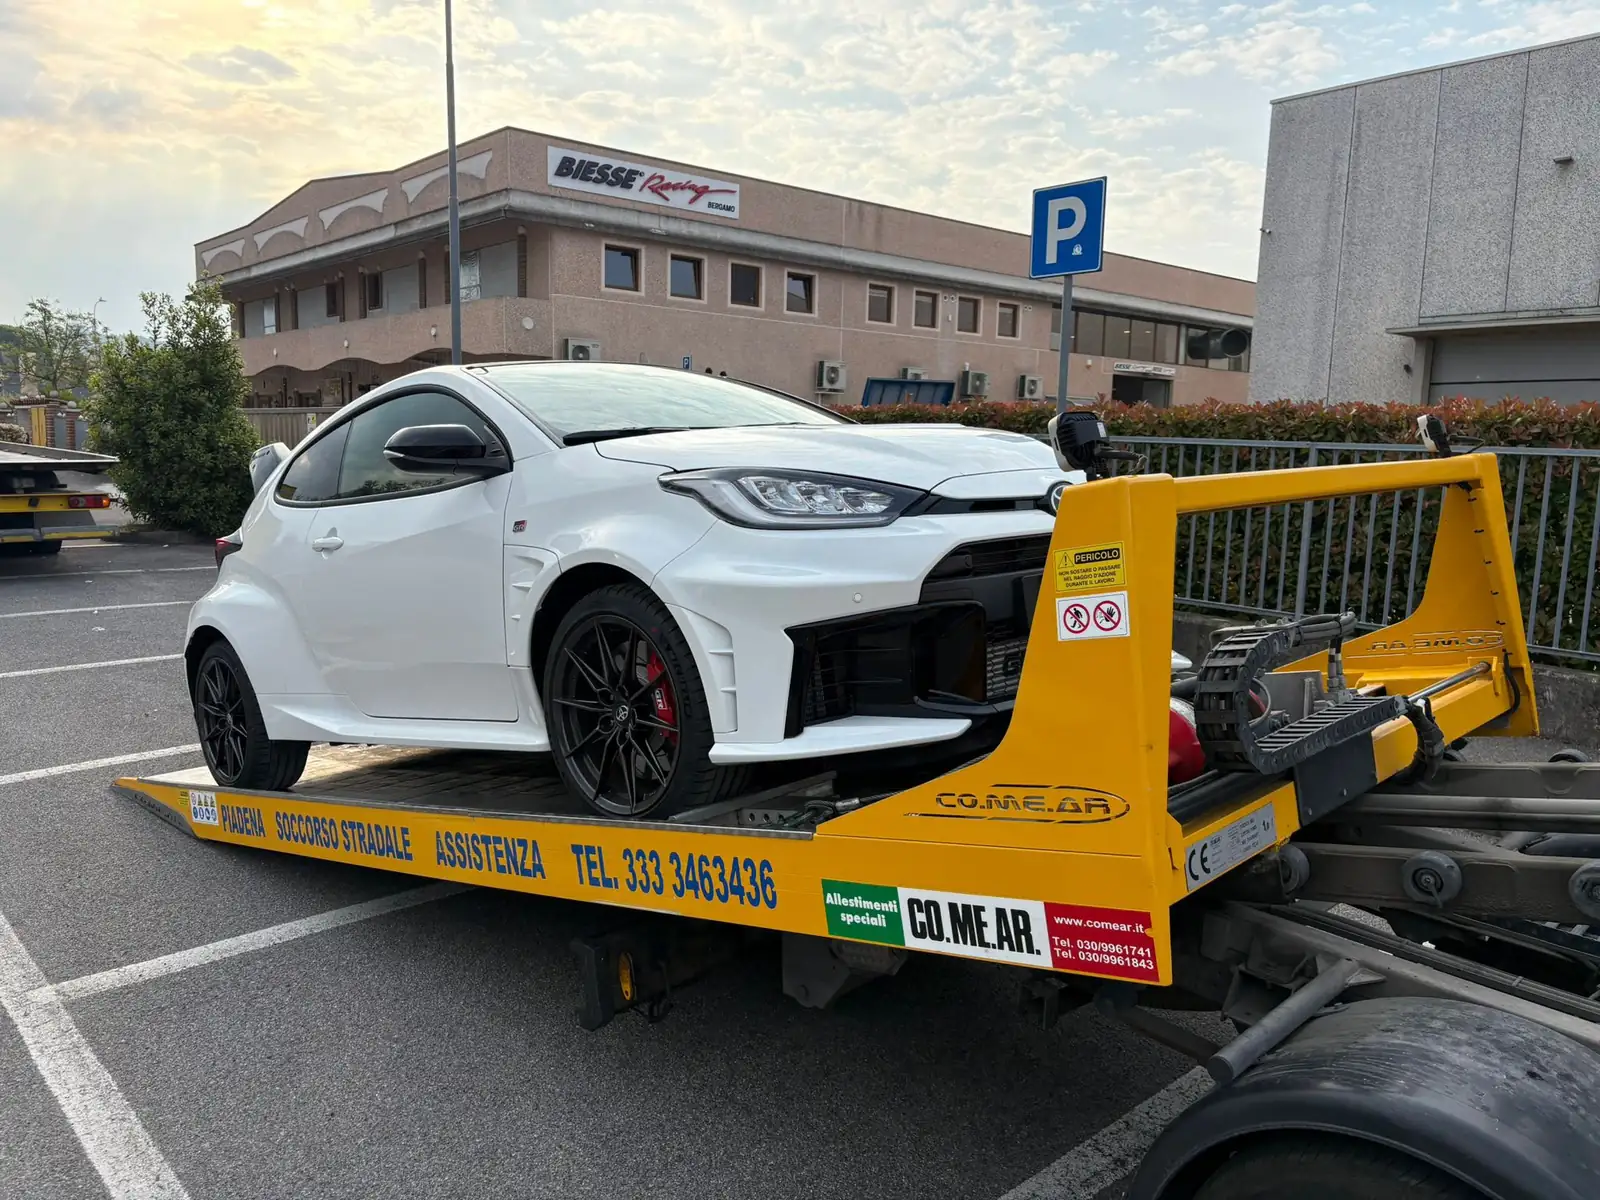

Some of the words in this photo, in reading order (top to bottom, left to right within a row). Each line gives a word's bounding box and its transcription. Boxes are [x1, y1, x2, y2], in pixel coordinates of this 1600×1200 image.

[554, 156, 639, 190] BIESSE
[639, 172, 738, 205] Racing
[707, 201, 736, 213] BERGAMO
[1045, 196, 1087, 264] P
[683, 358, 689, 367] P
[1075, 550, 1119, 563] PERICOLO
[1066, 580, 1088, 588] DURANTE
[221, 804, 266, 838] PIADENA
[275, 811, 339, 851] SOCCORSO
[340, 819, 414, 861] STRADALE
[435, 830, 547, 880] ASSISTENZA
[571, 843, 619, 890] TEL.
[622, 847, 665, 896] 333
[669, 851, 777, 910] 3463436
[825, 892, 898, 913] Allestimenti
[840, 912, 886, 927] speciali
[907, 897, 1042, 956] CO.ME.AR.
[1053, 916, 1145, 933] www.comear.it
[1052, 936, 1074, 948] Tel.
[1076, 939, 1151, 958] 030/9961741
[1053, 948, 1075, 959] Tel.
[1078, 951, 1154, 970] 030/9961843
